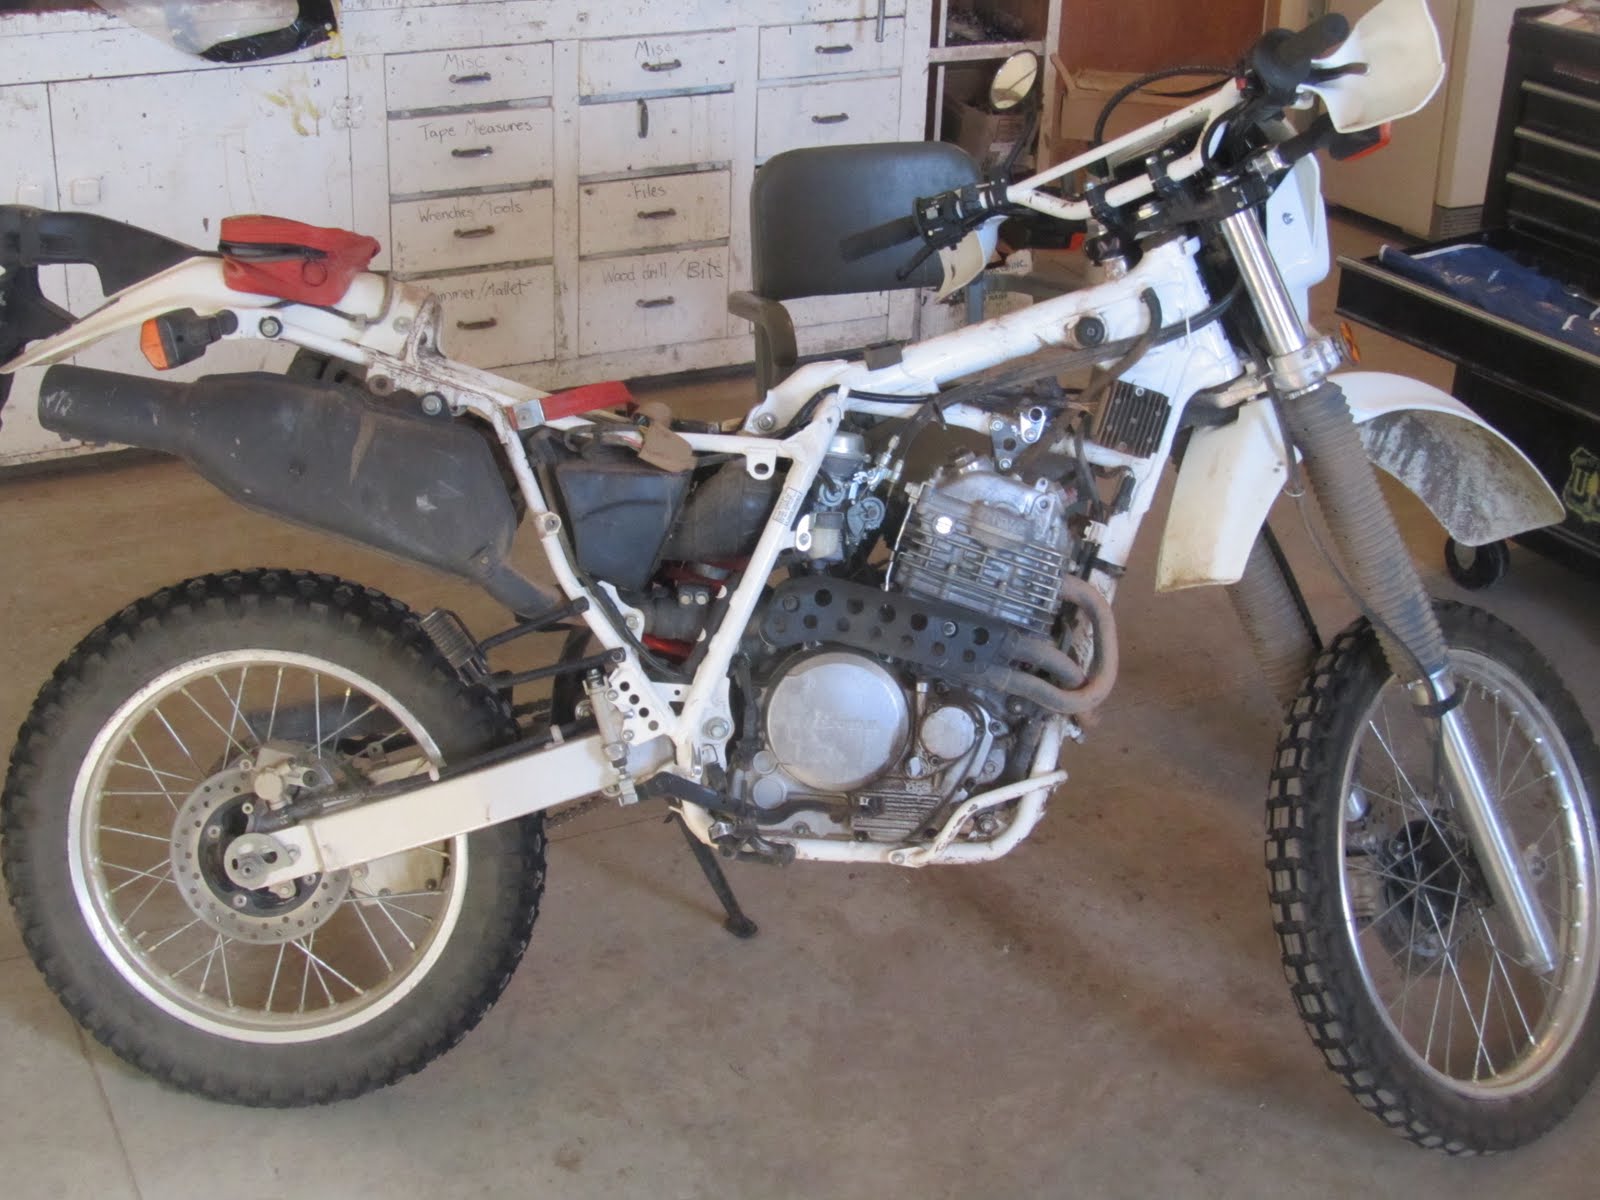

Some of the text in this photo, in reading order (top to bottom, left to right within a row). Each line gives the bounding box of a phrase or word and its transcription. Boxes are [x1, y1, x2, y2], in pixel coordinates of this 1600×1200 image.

[443, 53, 486, 71] Misc
[418, 119, 533, 143] Tape Measures
[633, 184, 667, 200] Files
